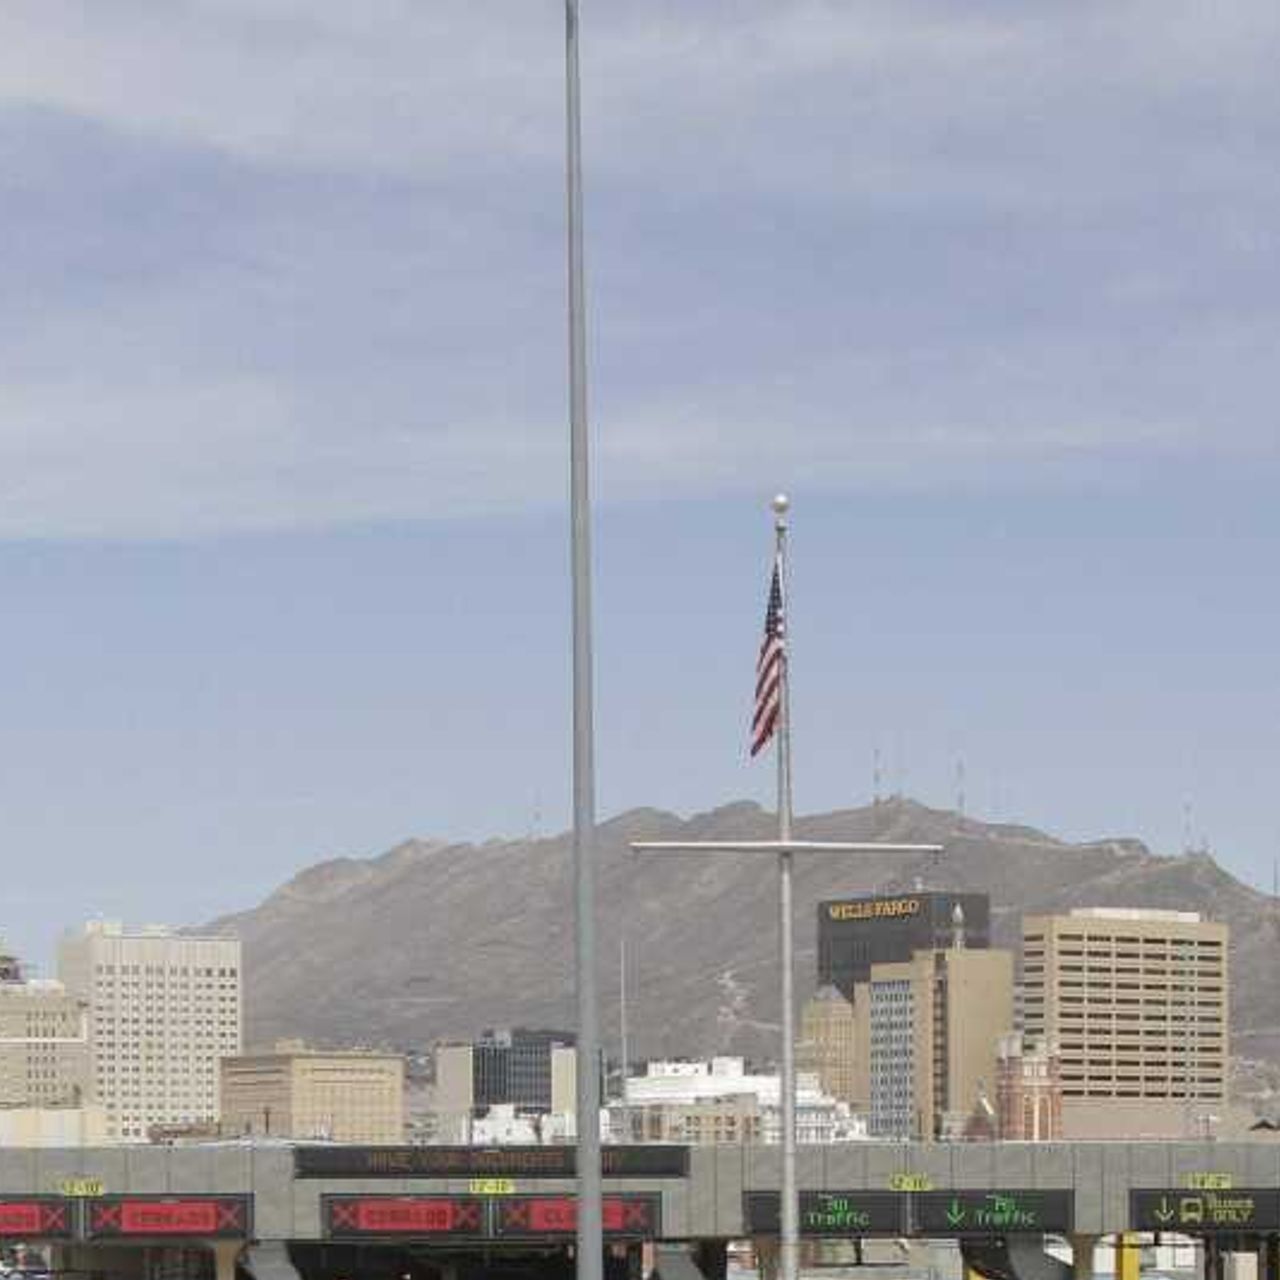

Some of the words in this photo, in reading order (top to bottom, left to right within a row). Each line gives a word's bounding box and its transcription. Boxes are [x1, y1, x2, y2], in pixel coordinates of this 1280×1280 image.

[829, 903, 874, 920] WELLS
[875, 901, 919, 916] FARGO
[807, 1211, 871, 1226] Traffic
[975, 1211, 1036, 1226] Traffic
[1213, 1209, 1252, 1224] ONLY
